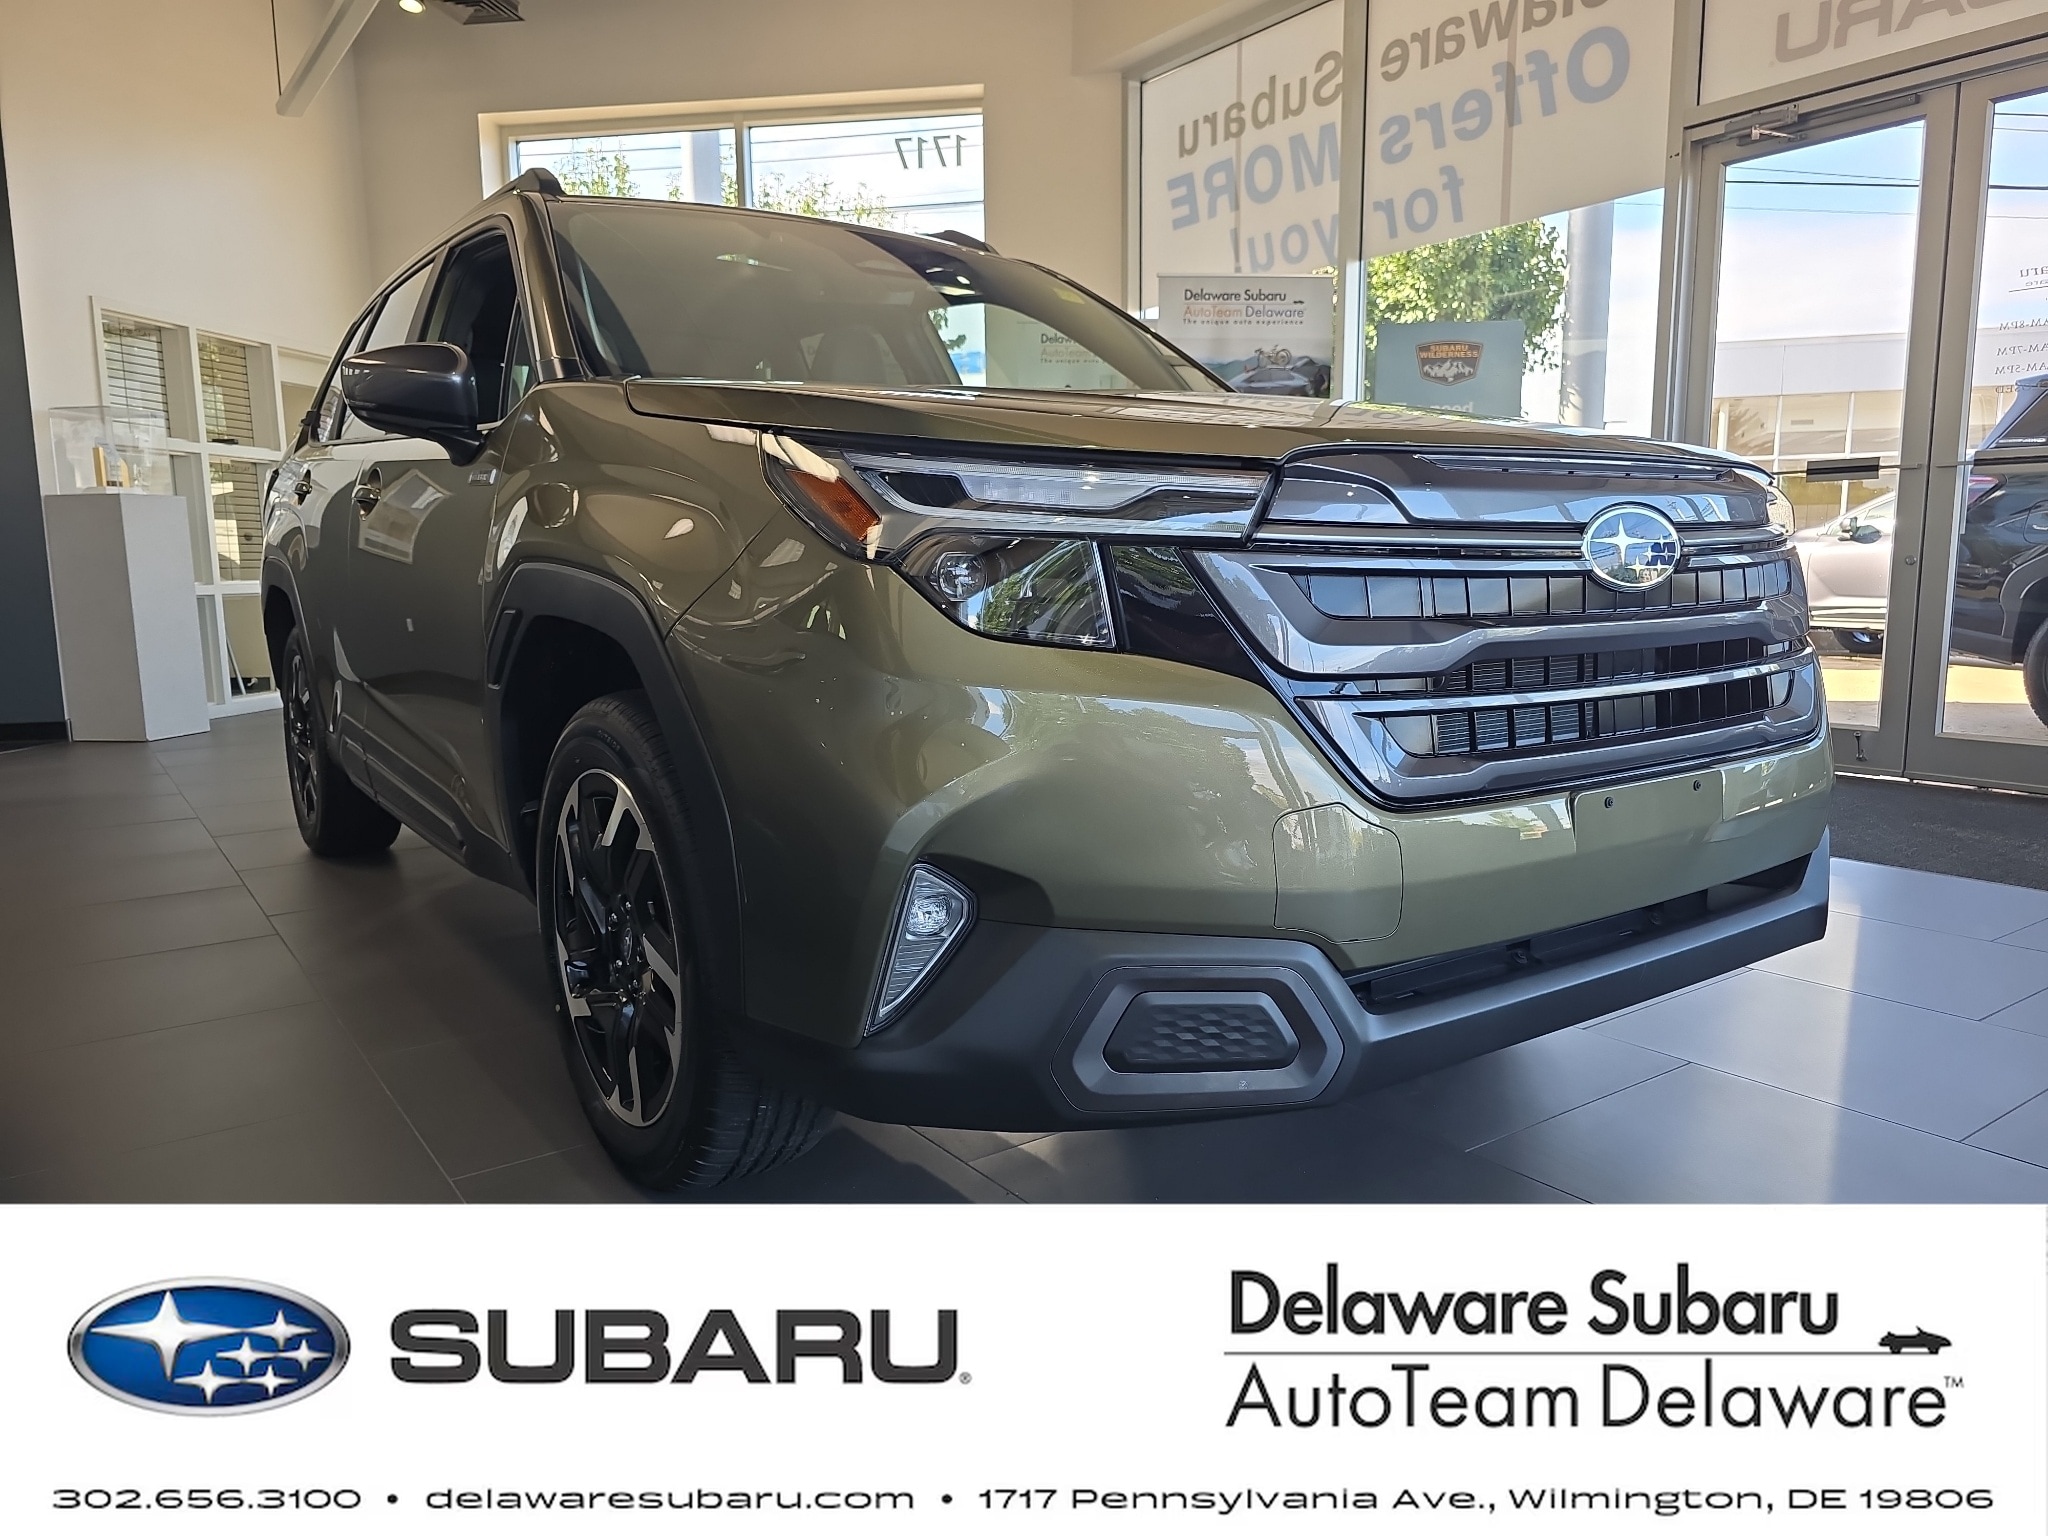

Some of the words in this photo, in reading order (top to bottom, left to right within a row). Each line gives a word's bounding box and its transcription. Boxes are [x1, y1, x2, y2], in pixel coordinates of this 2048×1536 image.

[1184, 288, 1241, 301] Delaware
[1244, 288, 1287, 301] Subaru
[1184, 306, 1242, 318] AutoTeam
[1245, 305, 1304, 318] Delaware
[1041, 333, 1077, 345] Delaw
[1429, 344, 1469, 352] SUBARU
[1419, 351, 1479, 359] WILDERNESS
